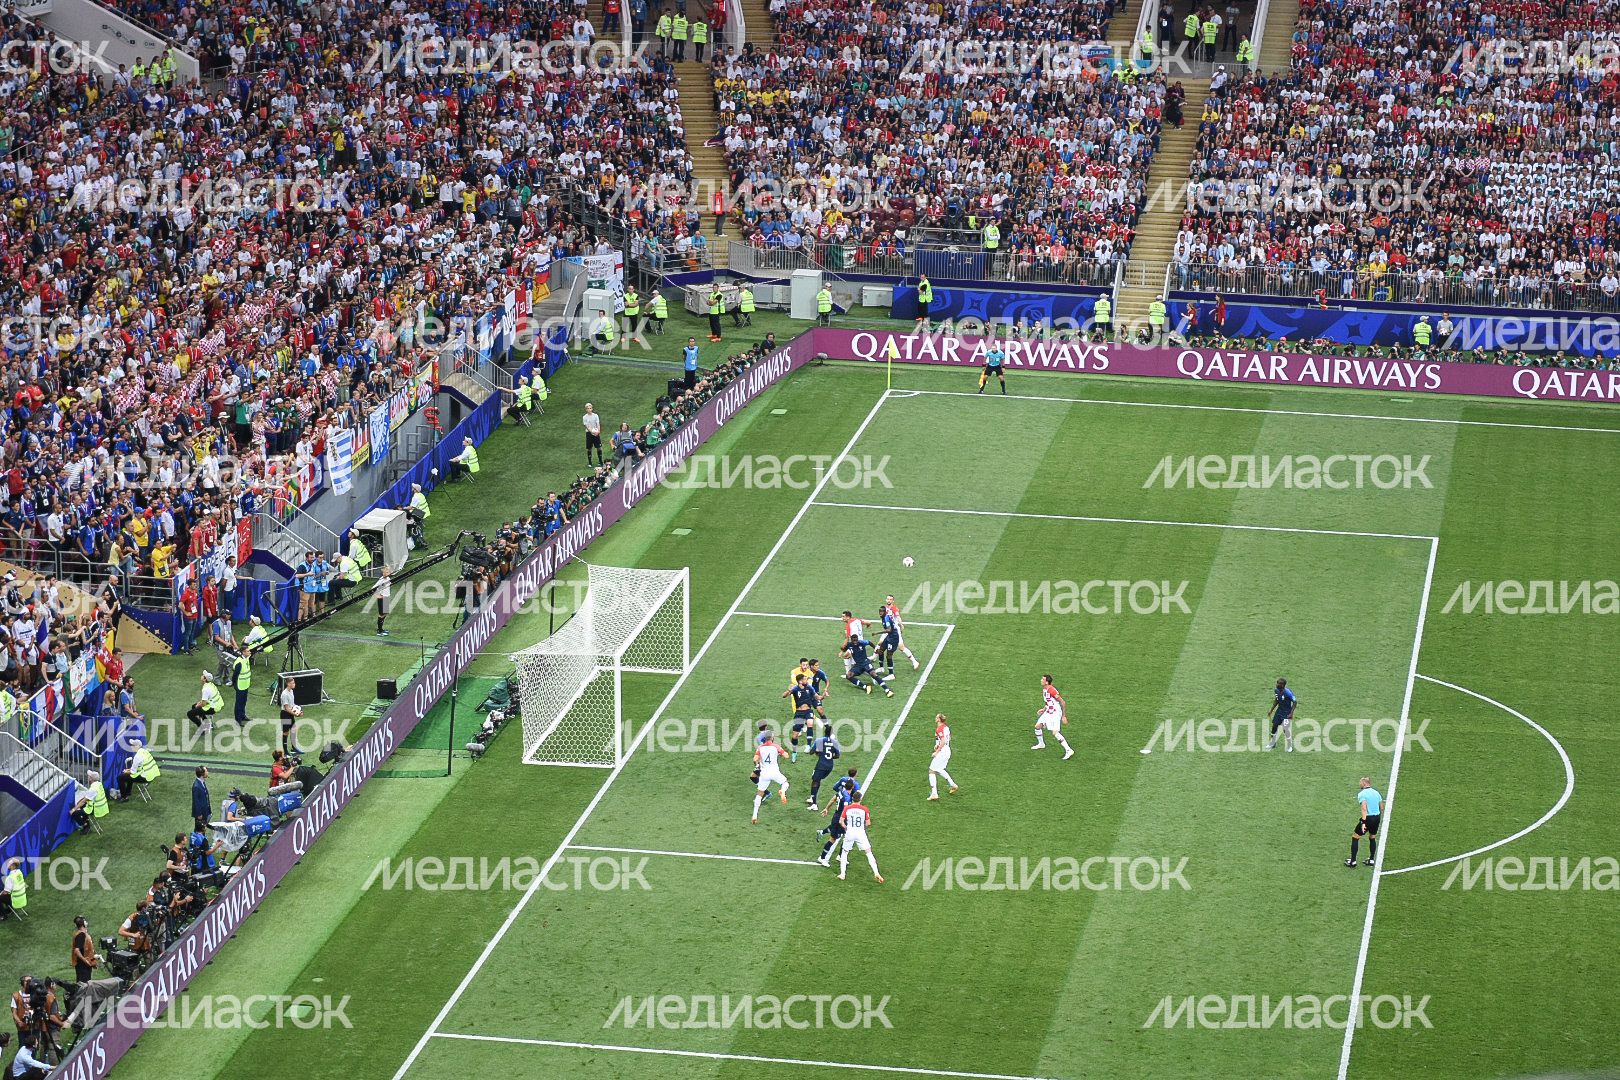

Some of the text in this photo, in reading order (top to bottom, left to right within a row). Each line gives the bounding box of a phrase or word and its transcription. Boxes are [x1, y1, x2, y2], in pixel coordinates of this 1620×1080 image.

[851, 333, 1109, 370] QATAR ARWAYS
[1176, 350, 1441, 389] QATAR AIRWAYS
[715, 346, 791, 426] QATAR AIRWAYS
[1512, 369, 1620, 398] QATAR
[622, 419, 699, 509] QATAR AIRWAYS
[516, 503, 603, 605] QATAR AIRWAYS
[414, 601, 497, 718] QATAR AIRWAYS
[764, 753, 771, 764] 4
[824, 747, 833, 759] 5
[293, 717, 394, 855] QATAR AIRWAYS
[850, 816, 862, 827] 18
[140, 859, 266, 1024] QATAR AIRWAYS
